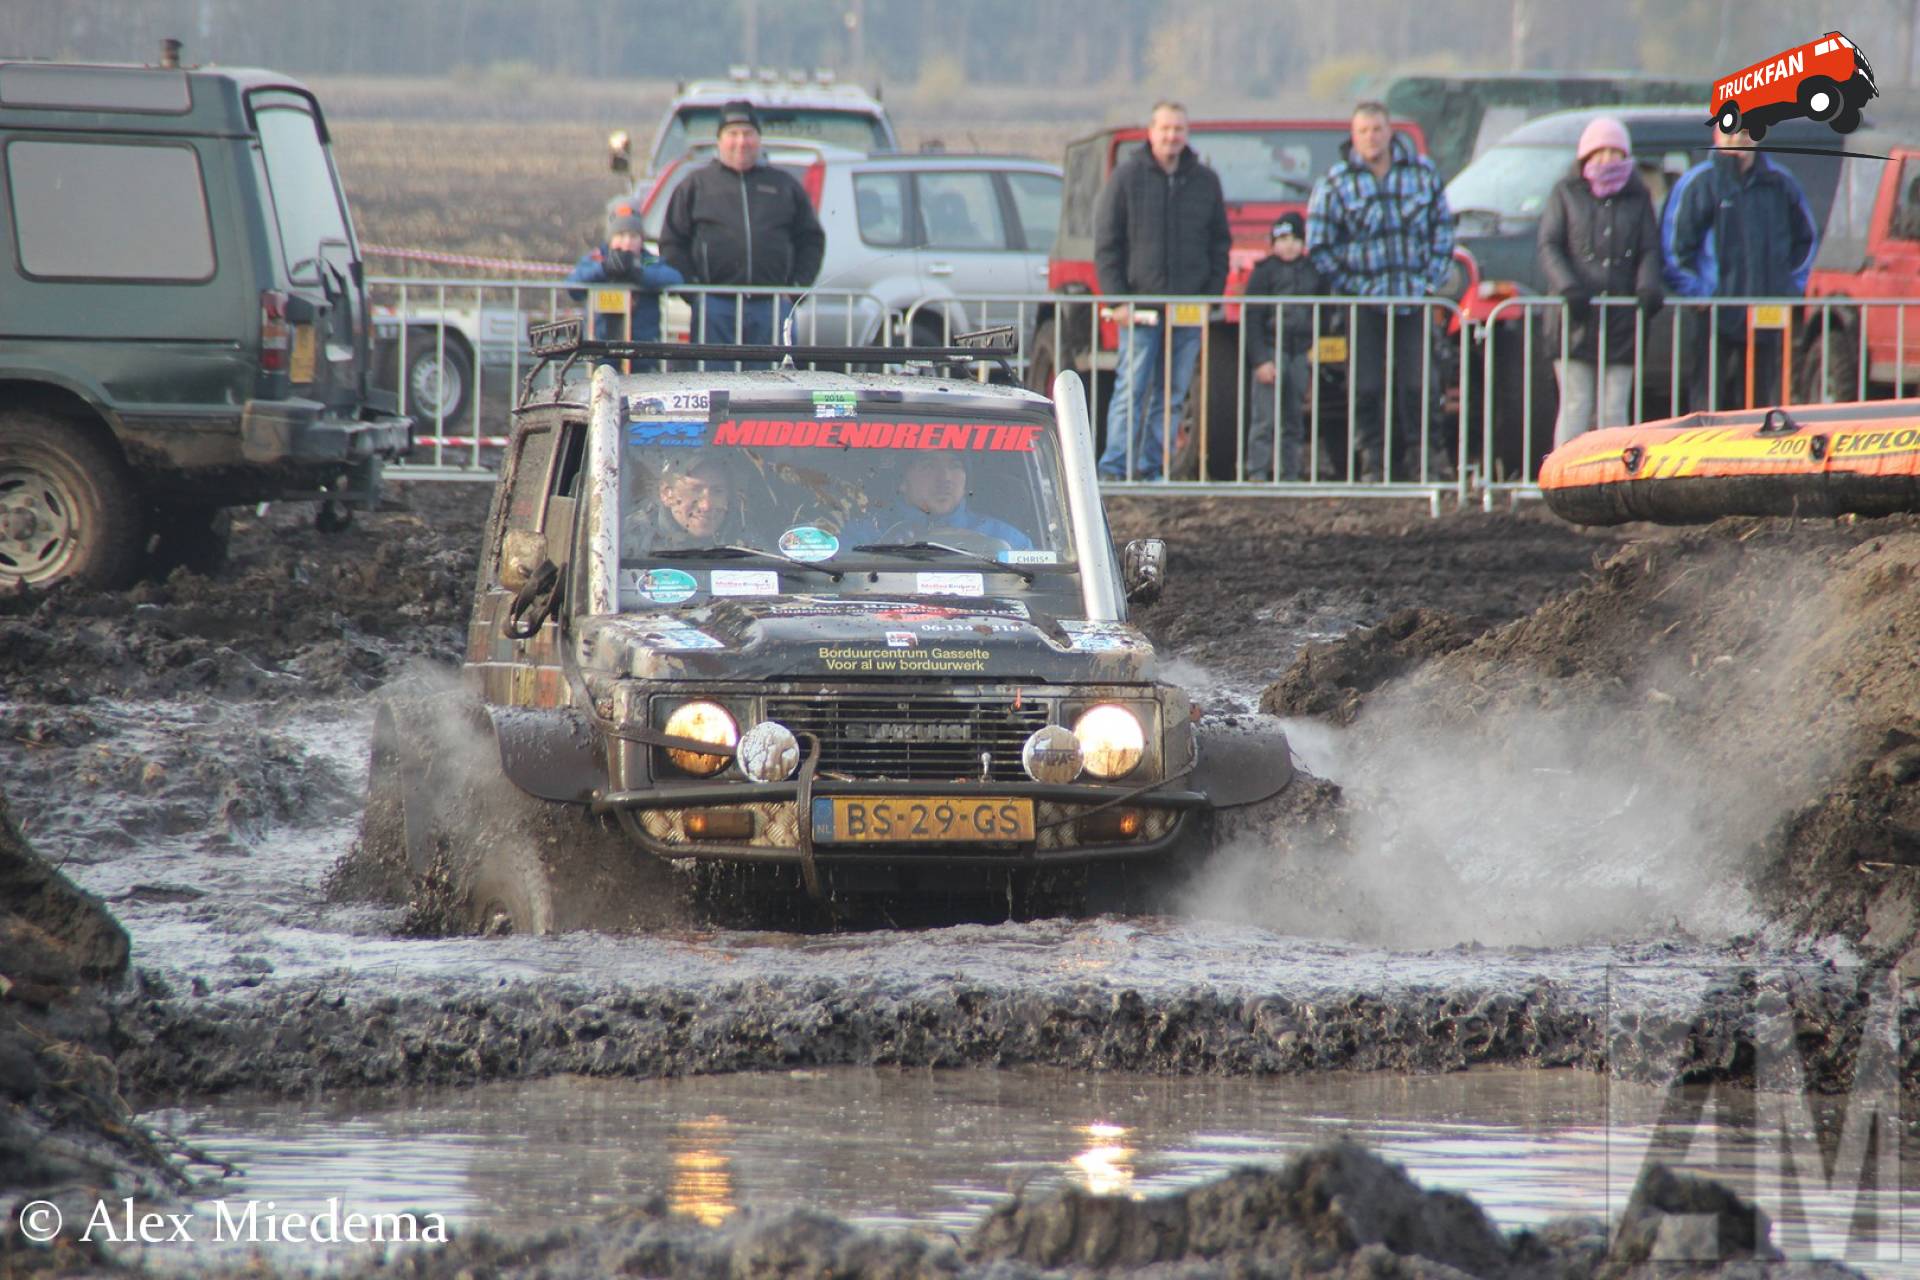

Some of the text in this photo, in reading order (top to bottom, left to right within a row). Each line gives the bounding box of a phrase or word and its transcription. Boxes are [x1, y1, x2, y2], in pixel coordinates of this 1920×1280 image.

[673, 395, 708, 409] 2736
[711, 419, 1044, 452] MIDDENDRENTHE
[1833, 429, 1920, 453] EXPLO
[1766, 438, 1807, 456] 200
[818, 647, 991, 660] Borduurcentrum Gasselte
[825, 659, 985, 671] Voor al uw borduurwerk
[846, 803, 1022, 836] BS-29-GS
